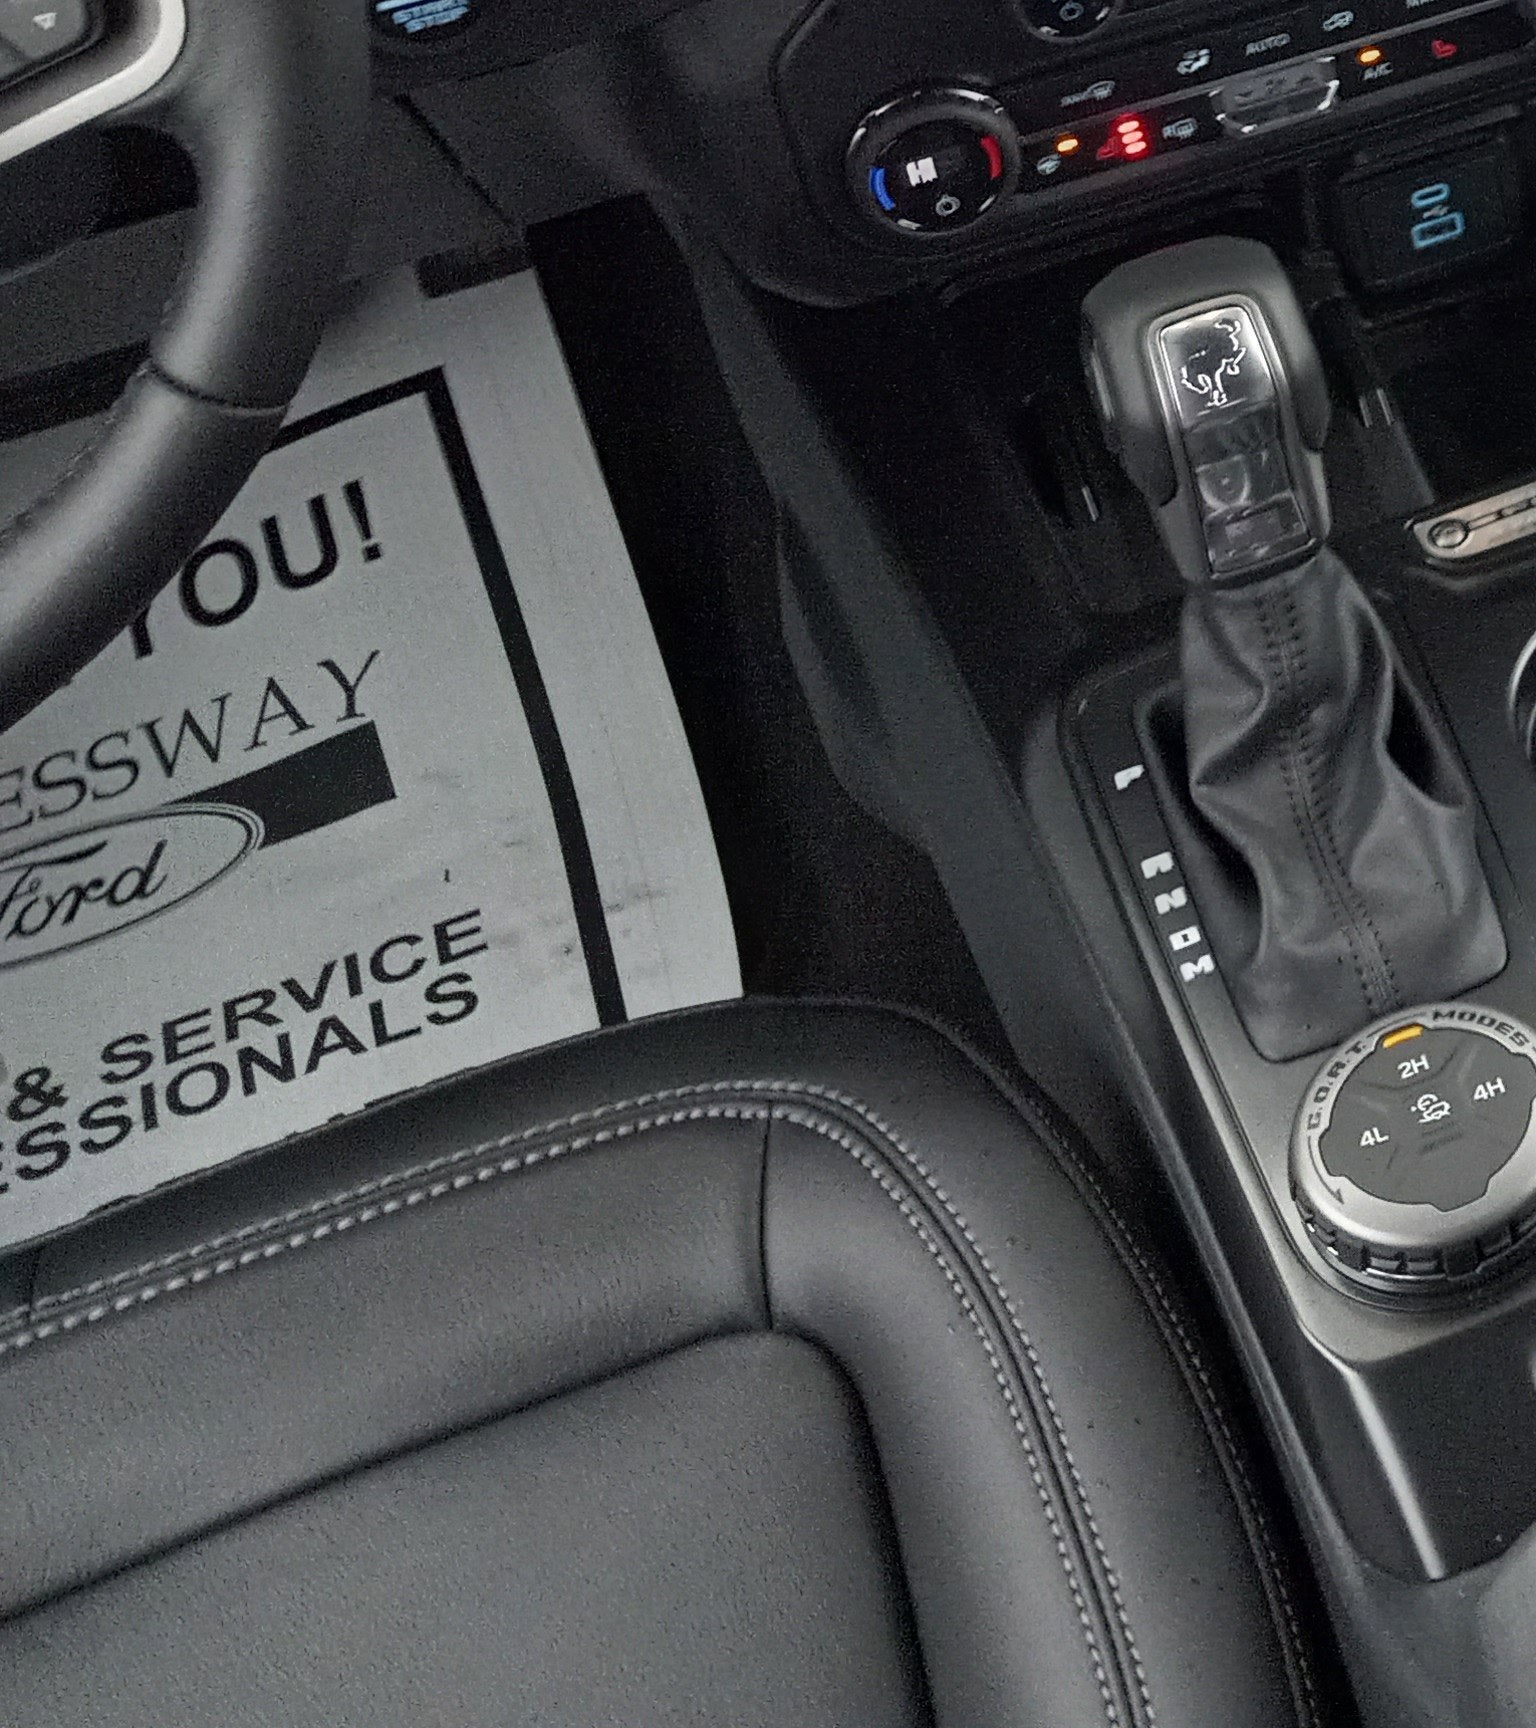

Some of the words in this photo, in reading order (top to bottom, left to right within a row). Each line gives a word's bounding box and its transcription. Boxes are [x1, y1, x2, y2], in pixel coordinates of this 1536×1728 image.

[1245, 32, 1291, 57] AUTO
[1363, 62, 1394, 82] A/C
[906, 156, 938, 187] HI
[1154, 885, 1188, 915] N
[1168, 924, 1202, 951] D
[1178, 954, 1215, 983] M
[8, 1066, 69, 1123] &
[99, 908, 489, 1085] SERVICE
[1432, 1008, 1531, 1047] MODES
[1396, 1053, 1431, 1080] 2H
[0, 971, 480, 1194] SSIONALS
[1472, 1076, 1507, 1103] 4H
[1358, 1126, 1390, 1148] 4L
